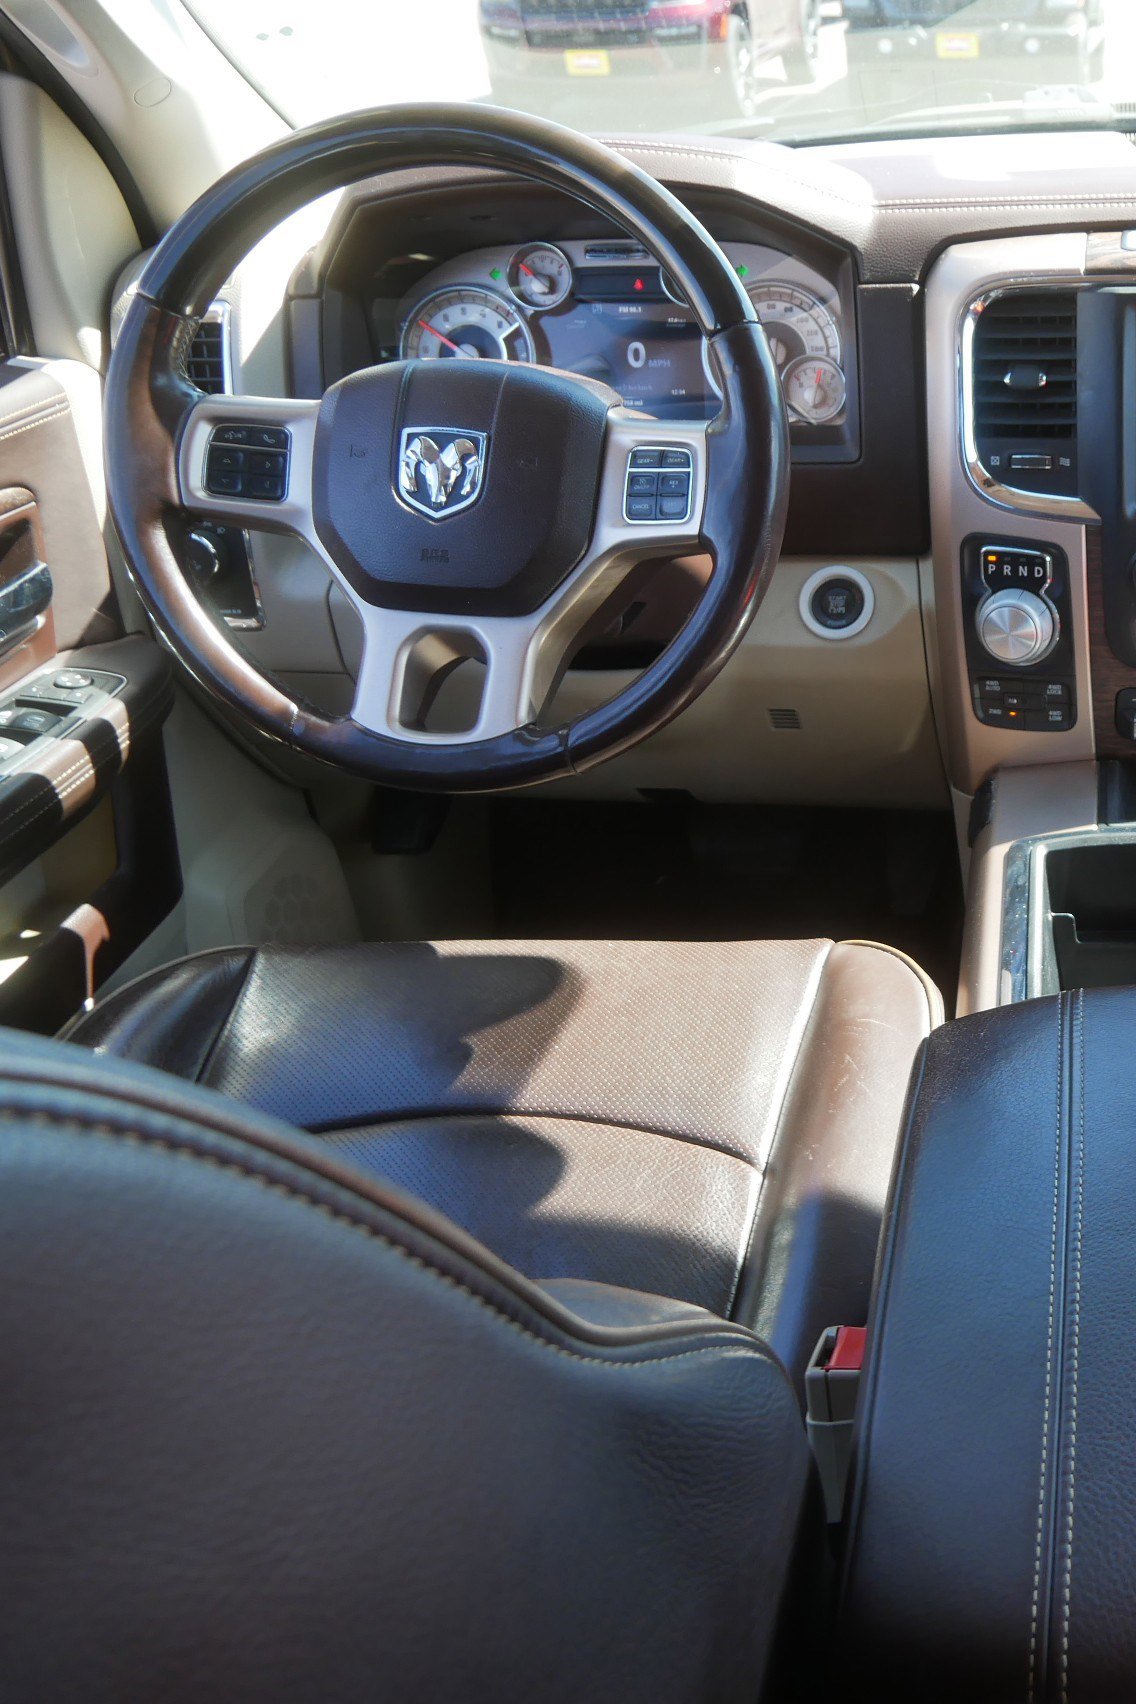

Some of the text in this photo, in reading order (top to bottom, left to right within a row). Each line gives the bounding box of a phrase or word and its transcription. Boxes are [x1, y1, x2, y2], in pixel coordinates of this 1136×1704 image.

[627, 341, 646, 369] 0
[987, 563, 1043, 578] P R N D
